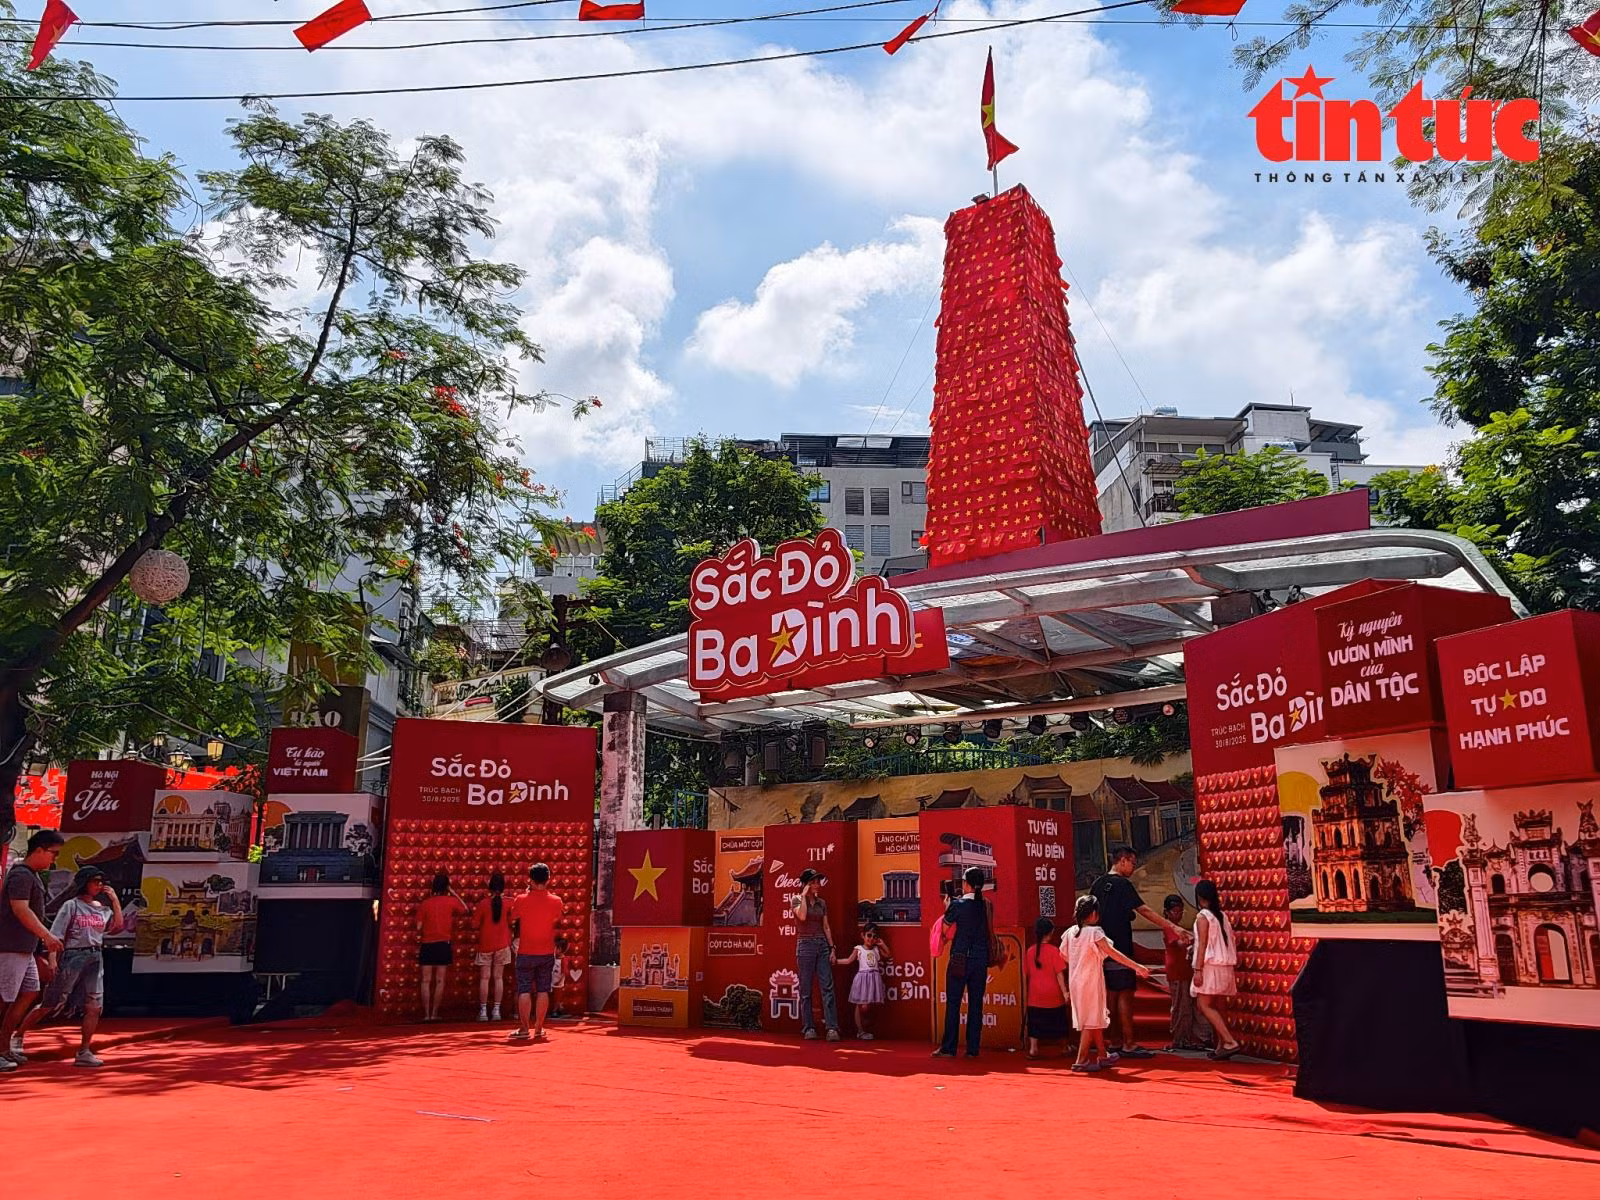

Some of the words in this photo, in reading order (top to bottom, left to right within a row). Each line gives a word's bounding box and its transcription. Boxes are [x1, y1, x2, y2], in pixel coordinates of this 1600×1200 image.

[694, 550, 772, 611] Sắc
[778, 540, 840, 596] Đỏ
[695, 629, 759, 681] Ba
[1373, 634, 1414, 658] MÌNH
[1360, 659, 1385, 678] của
[1463, 662, 1502, 687] ĐỘC
[1505, 653, 1546, 678] LẬP
[1216, 672, 1256, 711] Sắc
[1257, 666, 1288, 701] Đỏ
[1330, 680, 1371, 707] DÂN
[1375, 672, 1420, 702] TỘC
[1470, 693, 1497, 717] TỰ
[1519, 687, 1547, 708] DO
[1250, 712, 1286, 744] Ba
[1459, 726, 1512, 750] HẠNH
[1515, 714, 1571, 743] PHÚC
[302, 768, 329, 777] NAM
[431, 753, 476, 778] Sắc
[479, 758, 512, 779] Đỏ
[72, 789, 121, 821] Yêu
[467, 783, 504, 806] Ba
[1027, 818, 1058, 836] TUYẾN
[806, 847, 827, 861] TH
[1025, 838, 1043, 858] TÀU
[1044, 842, 1065, 862] ĐIỆN
[693, 856, 714, 874] Sắc
[1035, 863, 1048, 882] SỐ
[1049, 867, 1057, 882] 6
[904, 961, 925, 978] Đỏ
[993, 992, 1017, 1006] PHÁ
